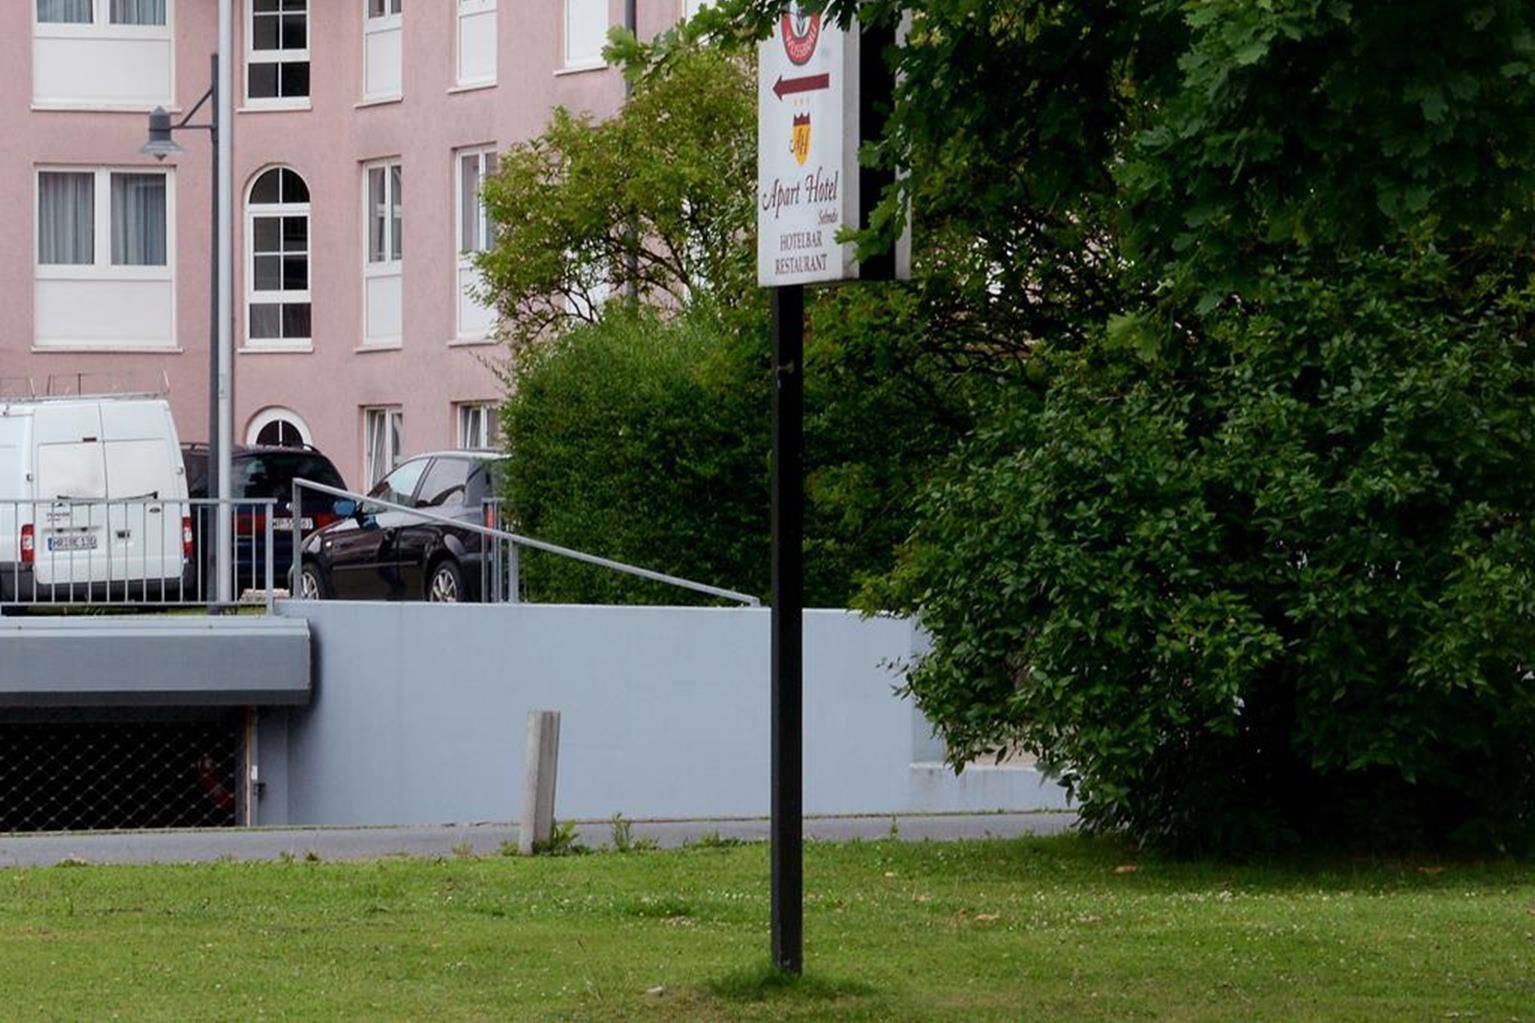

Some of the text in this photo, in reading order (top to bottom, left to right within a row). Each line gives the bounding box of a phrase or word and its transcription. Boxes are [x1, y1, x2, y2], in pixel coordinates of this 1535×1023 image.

[762, 165, 839, 219] Apart Hotel
[779, 230, 823, 251] HOTELBAR
[774, 253, 828, 275] RESTAURANT
